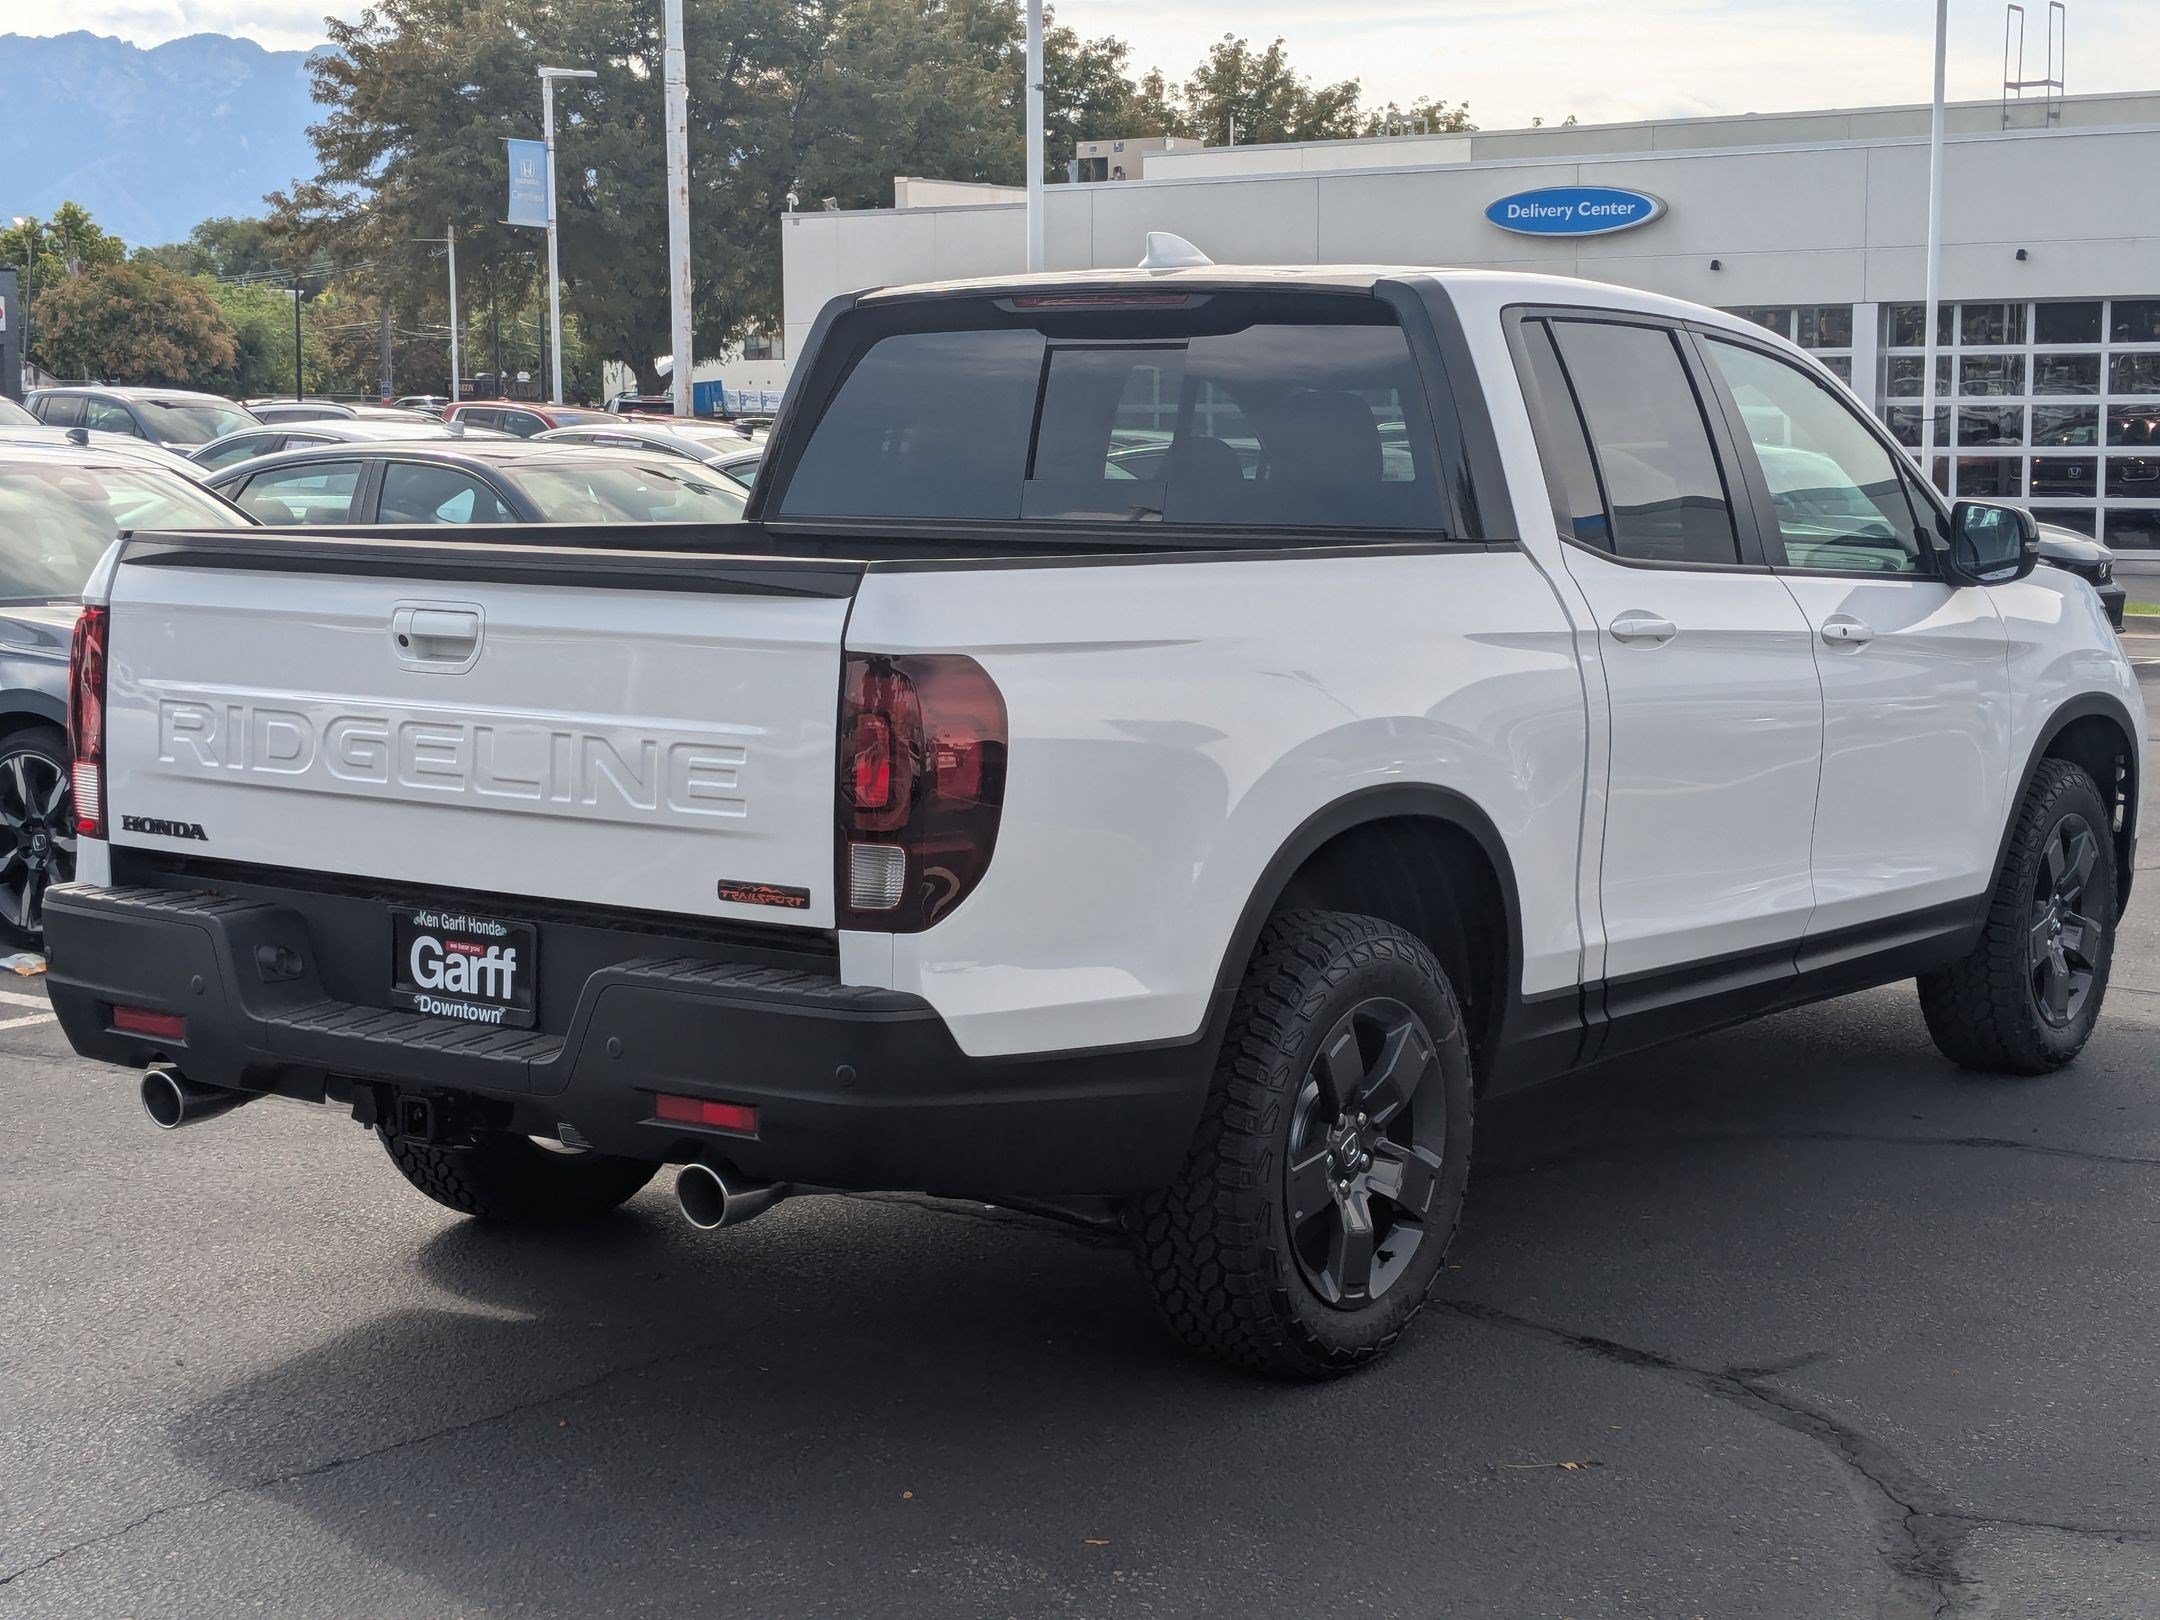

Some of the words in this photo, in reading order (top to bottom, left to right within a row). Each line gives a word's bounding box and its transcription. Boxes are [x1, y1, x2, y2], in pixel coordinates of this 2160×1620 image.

[1507, 203, 1573, 221] Delivery
[1578, 202, 1635, 216] Center
[159, 699, 747, 818] RIDGELINE
[121, 815, 209, 841] HONDA
[720, 889, 805, 907] TRAILSPORT
[419, 910, 439, 929] Ken
[441, 913, 466, 932] Garff
[468, 917, 501, 936] Honda
[410, 935, 517, 1000] Garff
[419, 995, 502, 1024] Downtown
